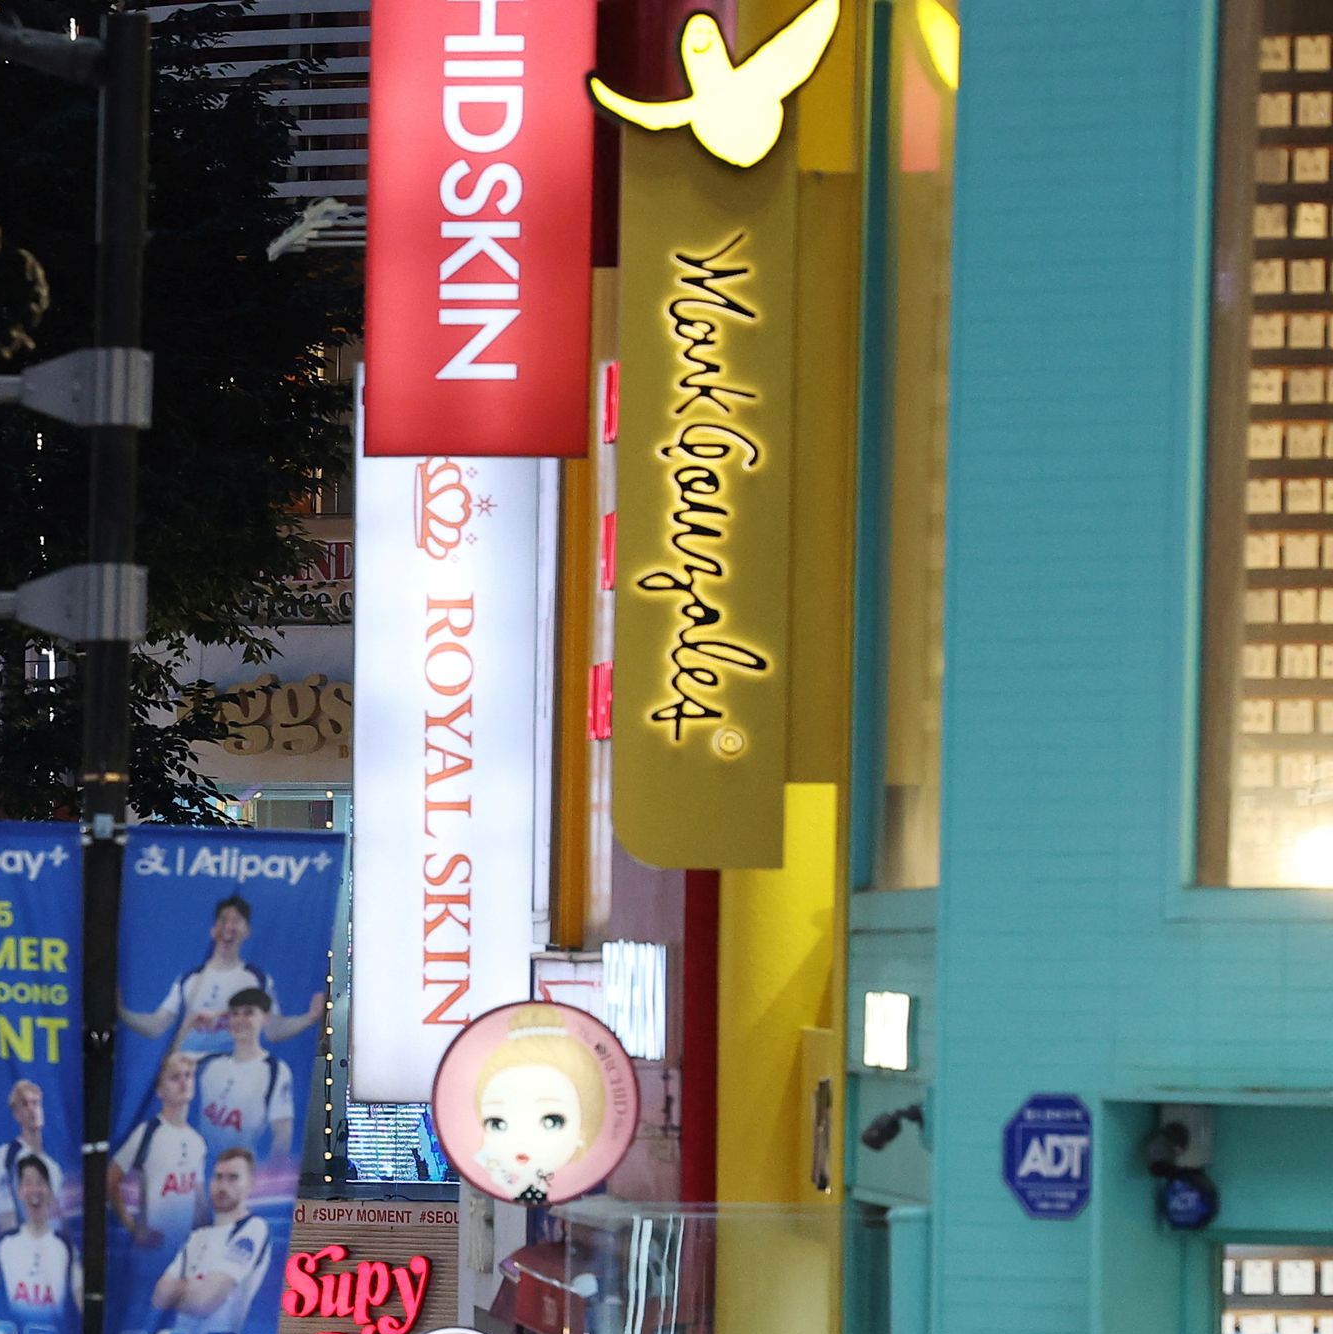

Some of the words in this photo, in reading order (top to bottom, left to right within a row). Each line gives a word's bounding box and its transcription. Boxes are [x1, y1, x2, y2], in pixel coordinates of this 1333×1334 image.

[424, 592, 475, 838] ROYAL
[422, 852, 473, 1028] SKIN
[1016, 1133, 1090, 1179] ADT
[312, 1207, 353, 1222] #SUPY
[356, 1209, 413, 1224] MOMENT
